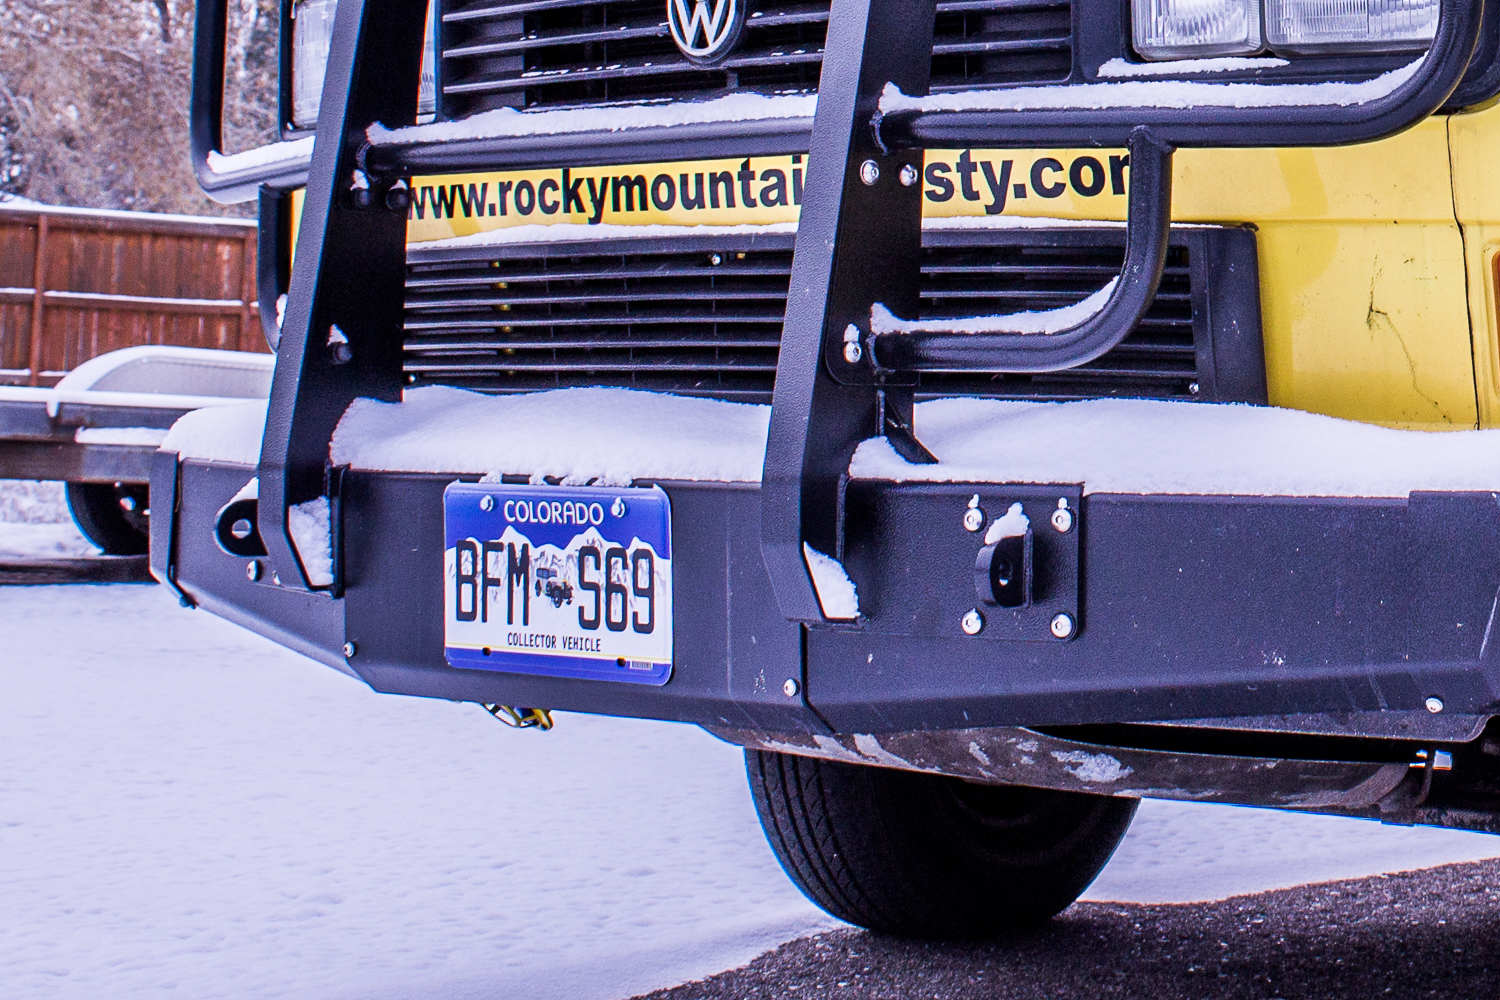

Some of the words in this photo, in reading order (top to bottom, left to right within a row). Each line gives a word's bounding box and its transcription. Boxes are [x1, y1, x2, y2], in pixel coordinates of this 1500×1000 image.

[504, 500, 604, 525] COLORADO
[455, 539, 530, 626] BFM
[577, 545, 655, 634] S69
[507, 632, 558, 650] COLLECTOR
[562, 636, 602, 653] VEHICLE
